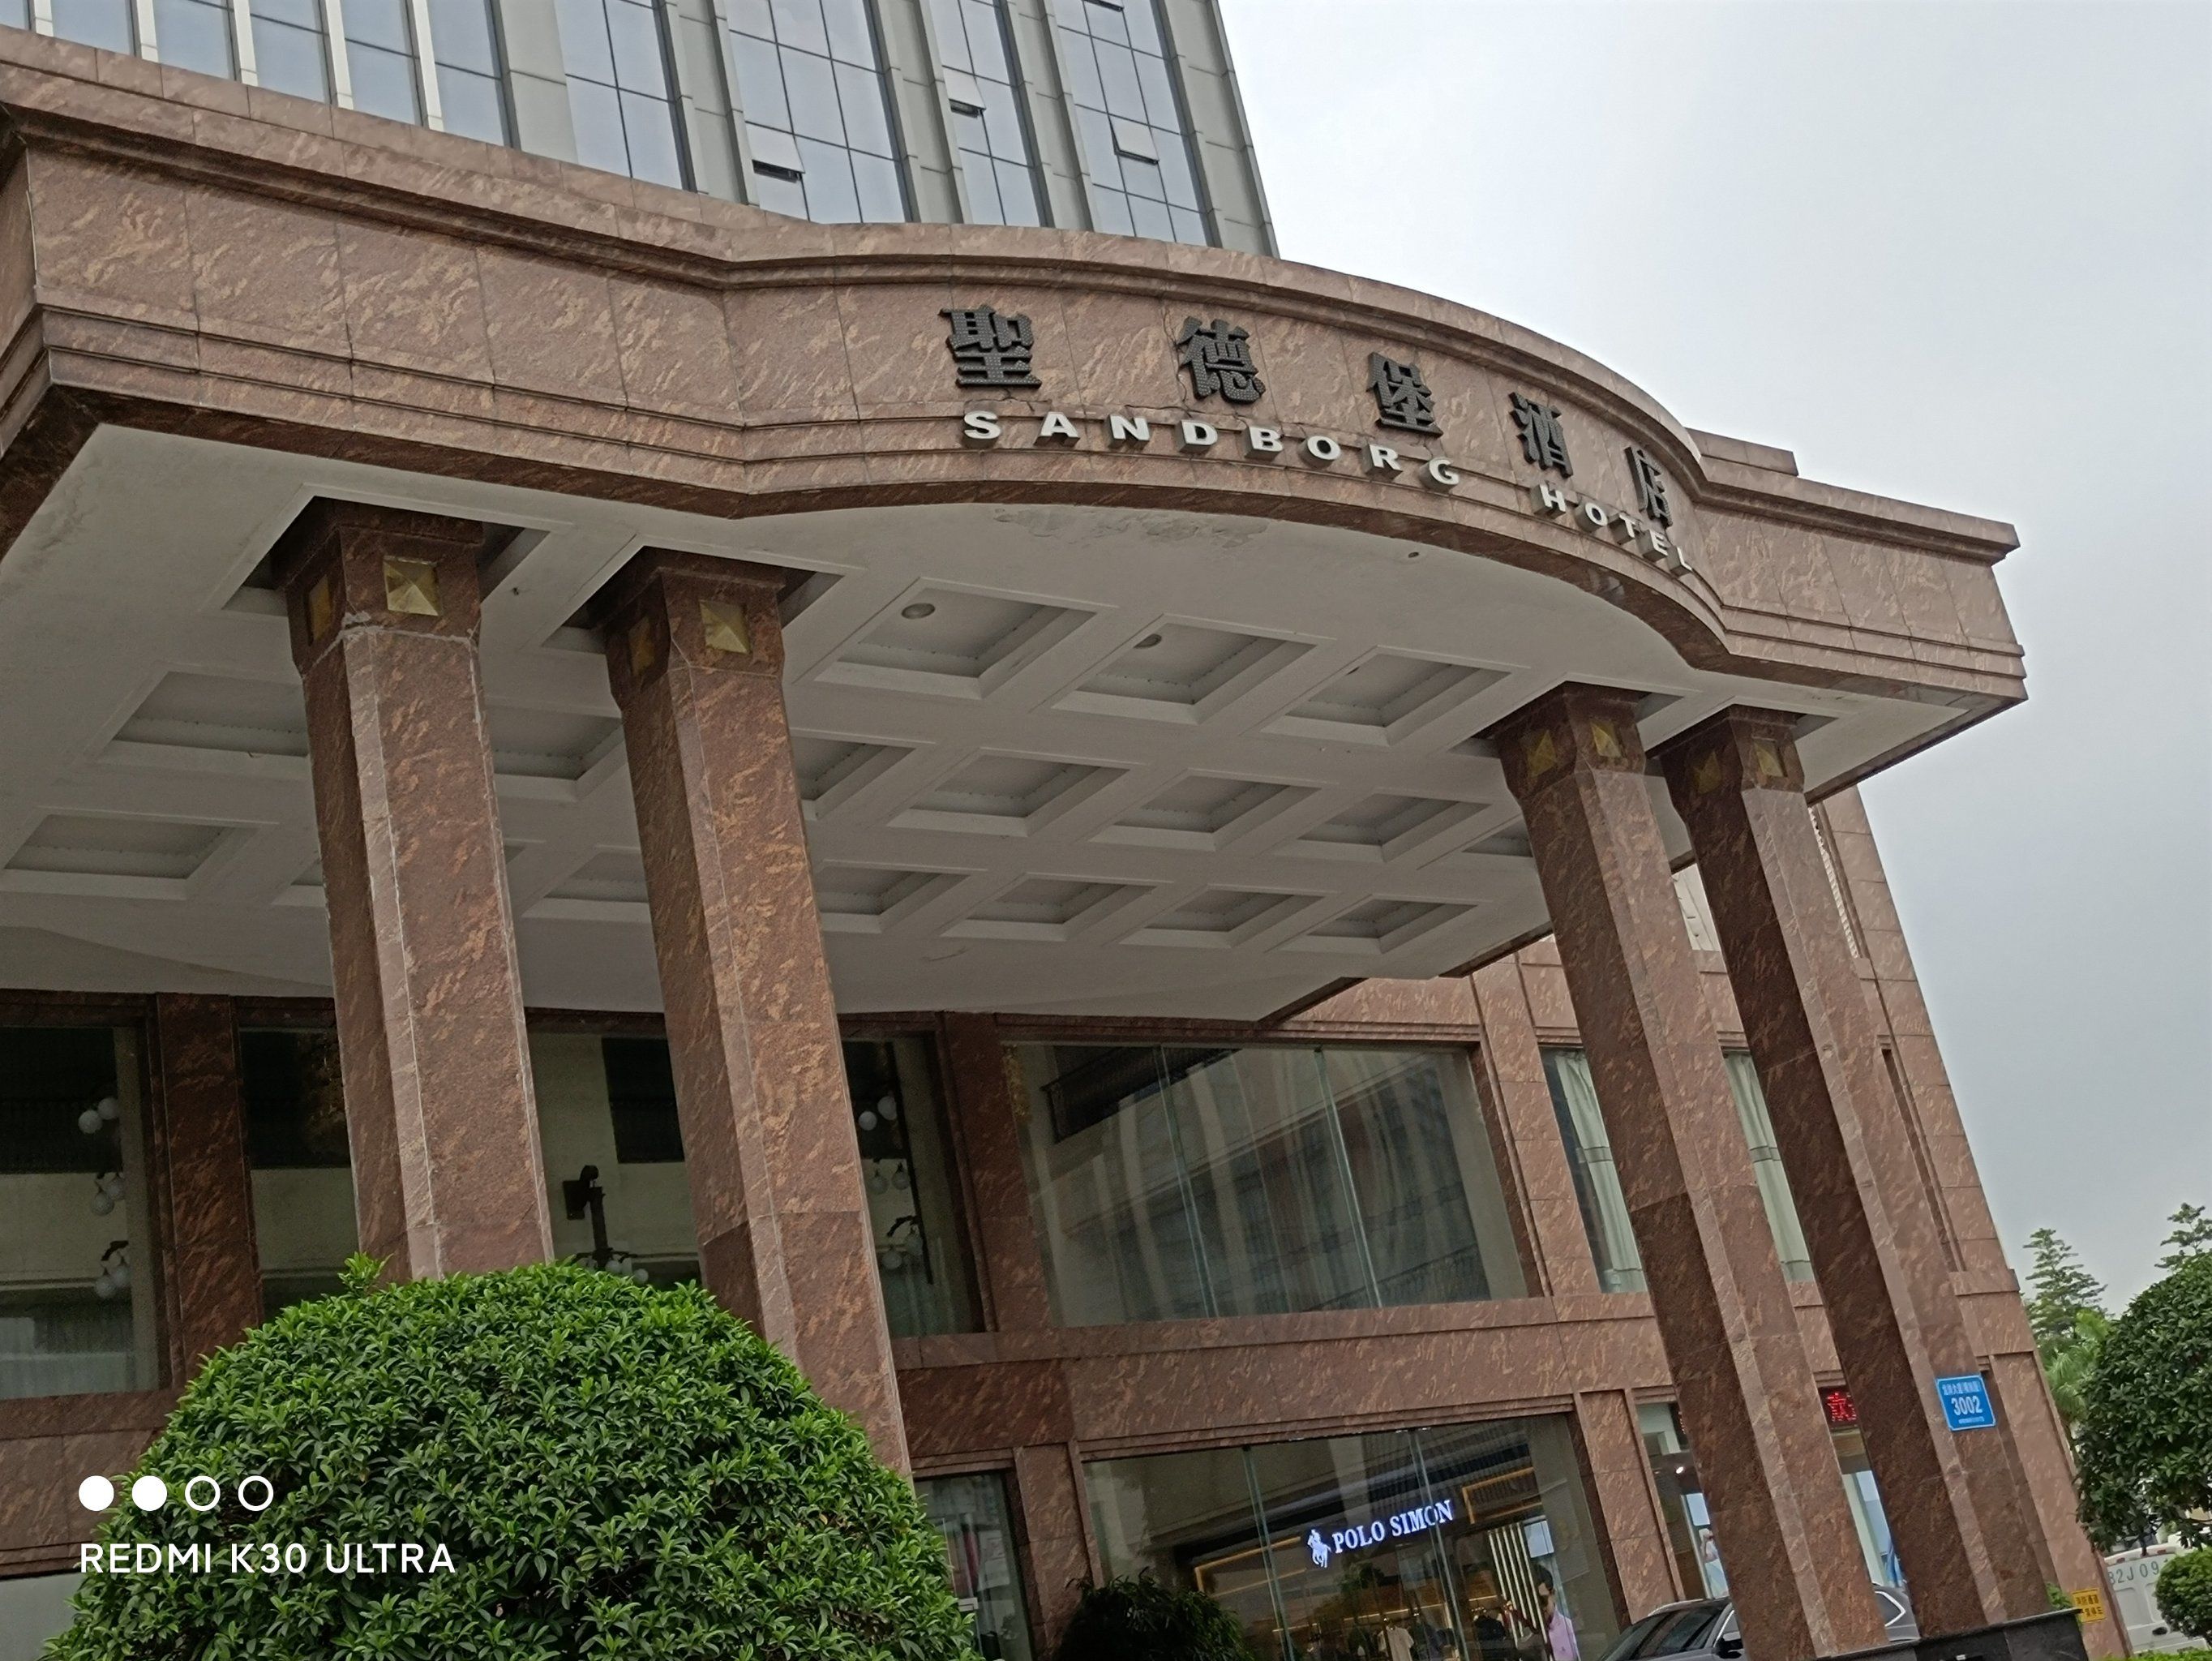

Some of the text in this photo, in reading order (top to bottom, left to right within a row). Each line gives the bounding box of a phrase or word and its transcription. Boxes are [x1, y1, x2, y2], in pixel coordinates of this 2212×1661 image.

[962, 410, 1692, 576] SANDBORG HOTEL
[1951, 1395, 1983, 1416] 3002
[1331, 1500, 1454, 1554] POLO SIMON
